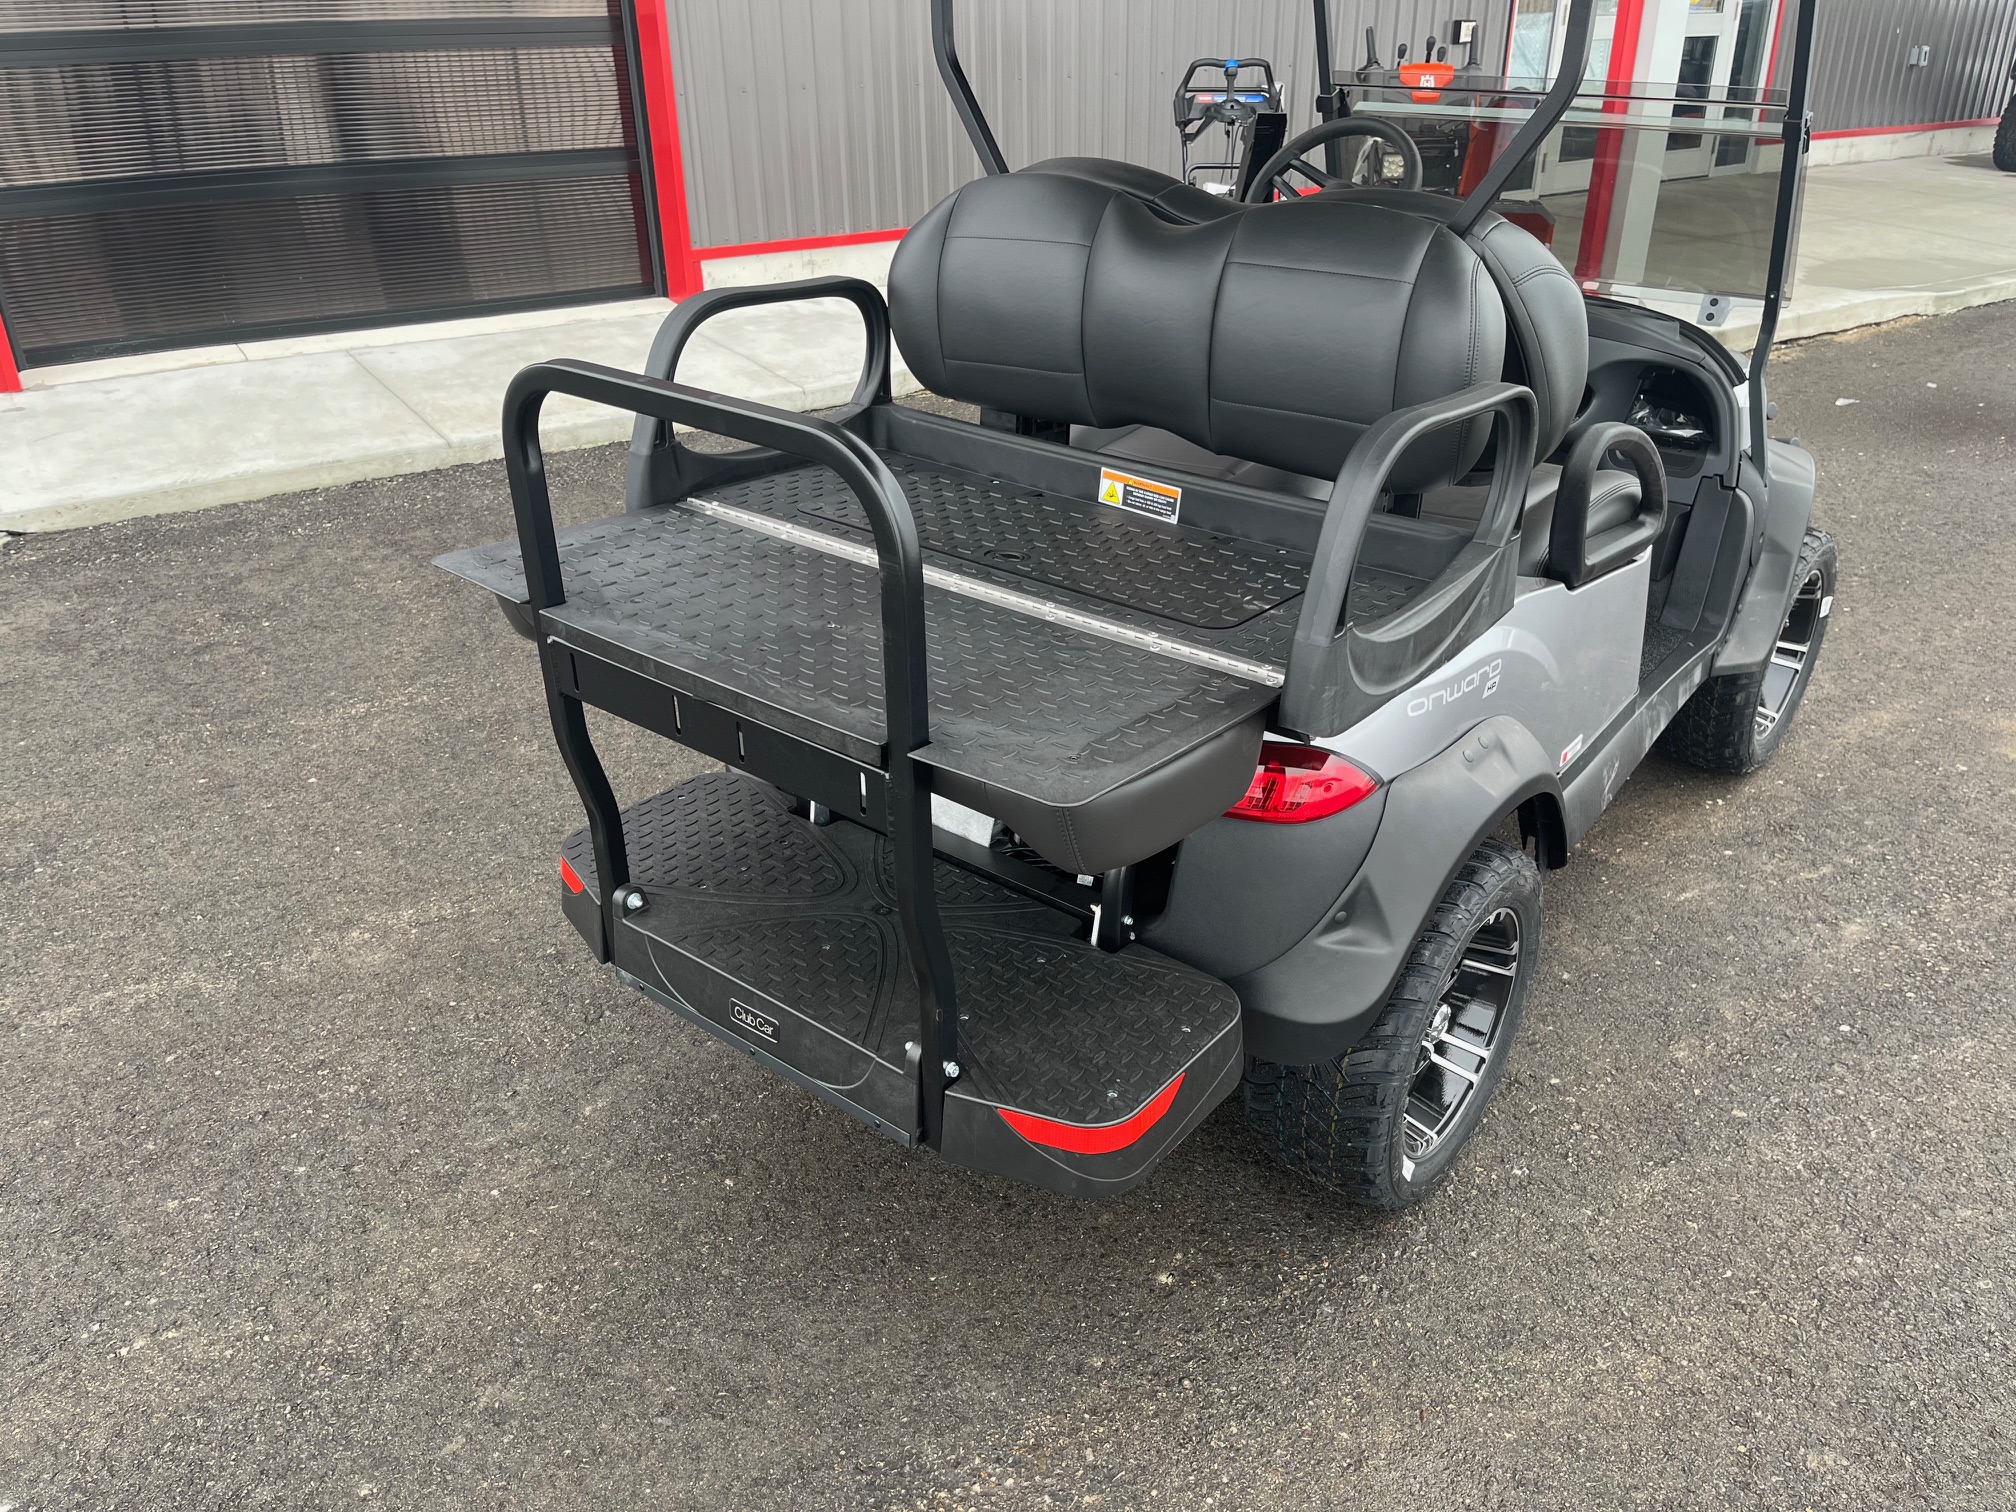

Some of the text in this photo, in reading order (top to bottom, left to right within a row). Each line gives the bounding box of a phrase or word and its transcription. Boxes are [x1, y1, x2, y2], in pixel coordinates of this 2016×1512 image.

[1486, 681, 1497, 693] HP
[734, 1006, 774, 1035] Club Car
